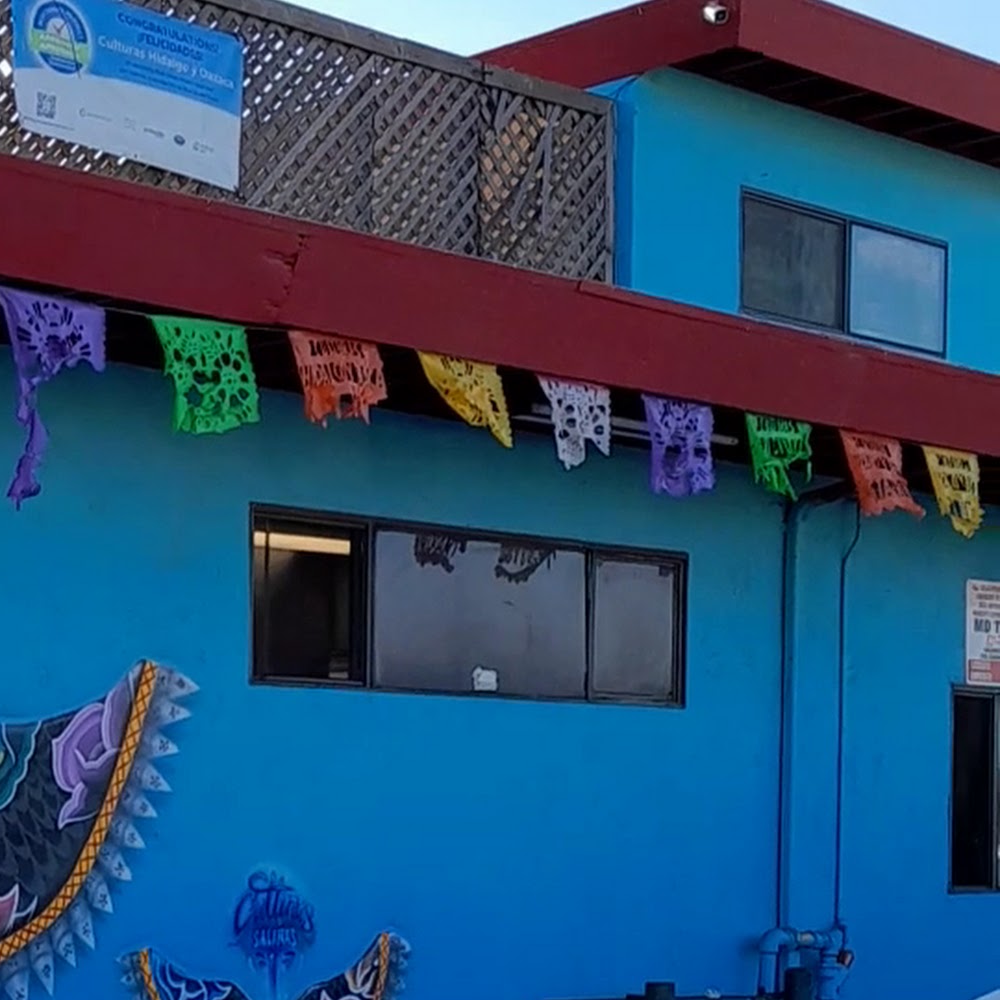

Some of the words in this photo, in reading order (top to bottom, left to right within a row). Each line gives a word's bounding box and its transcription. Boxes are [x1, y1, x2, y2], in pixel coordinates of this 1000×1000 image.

[98, 35, 146, 60] Culturas
[148, 50, 190, 74] Hidalgo
[199, 67, 236, 89] Oaxaca
